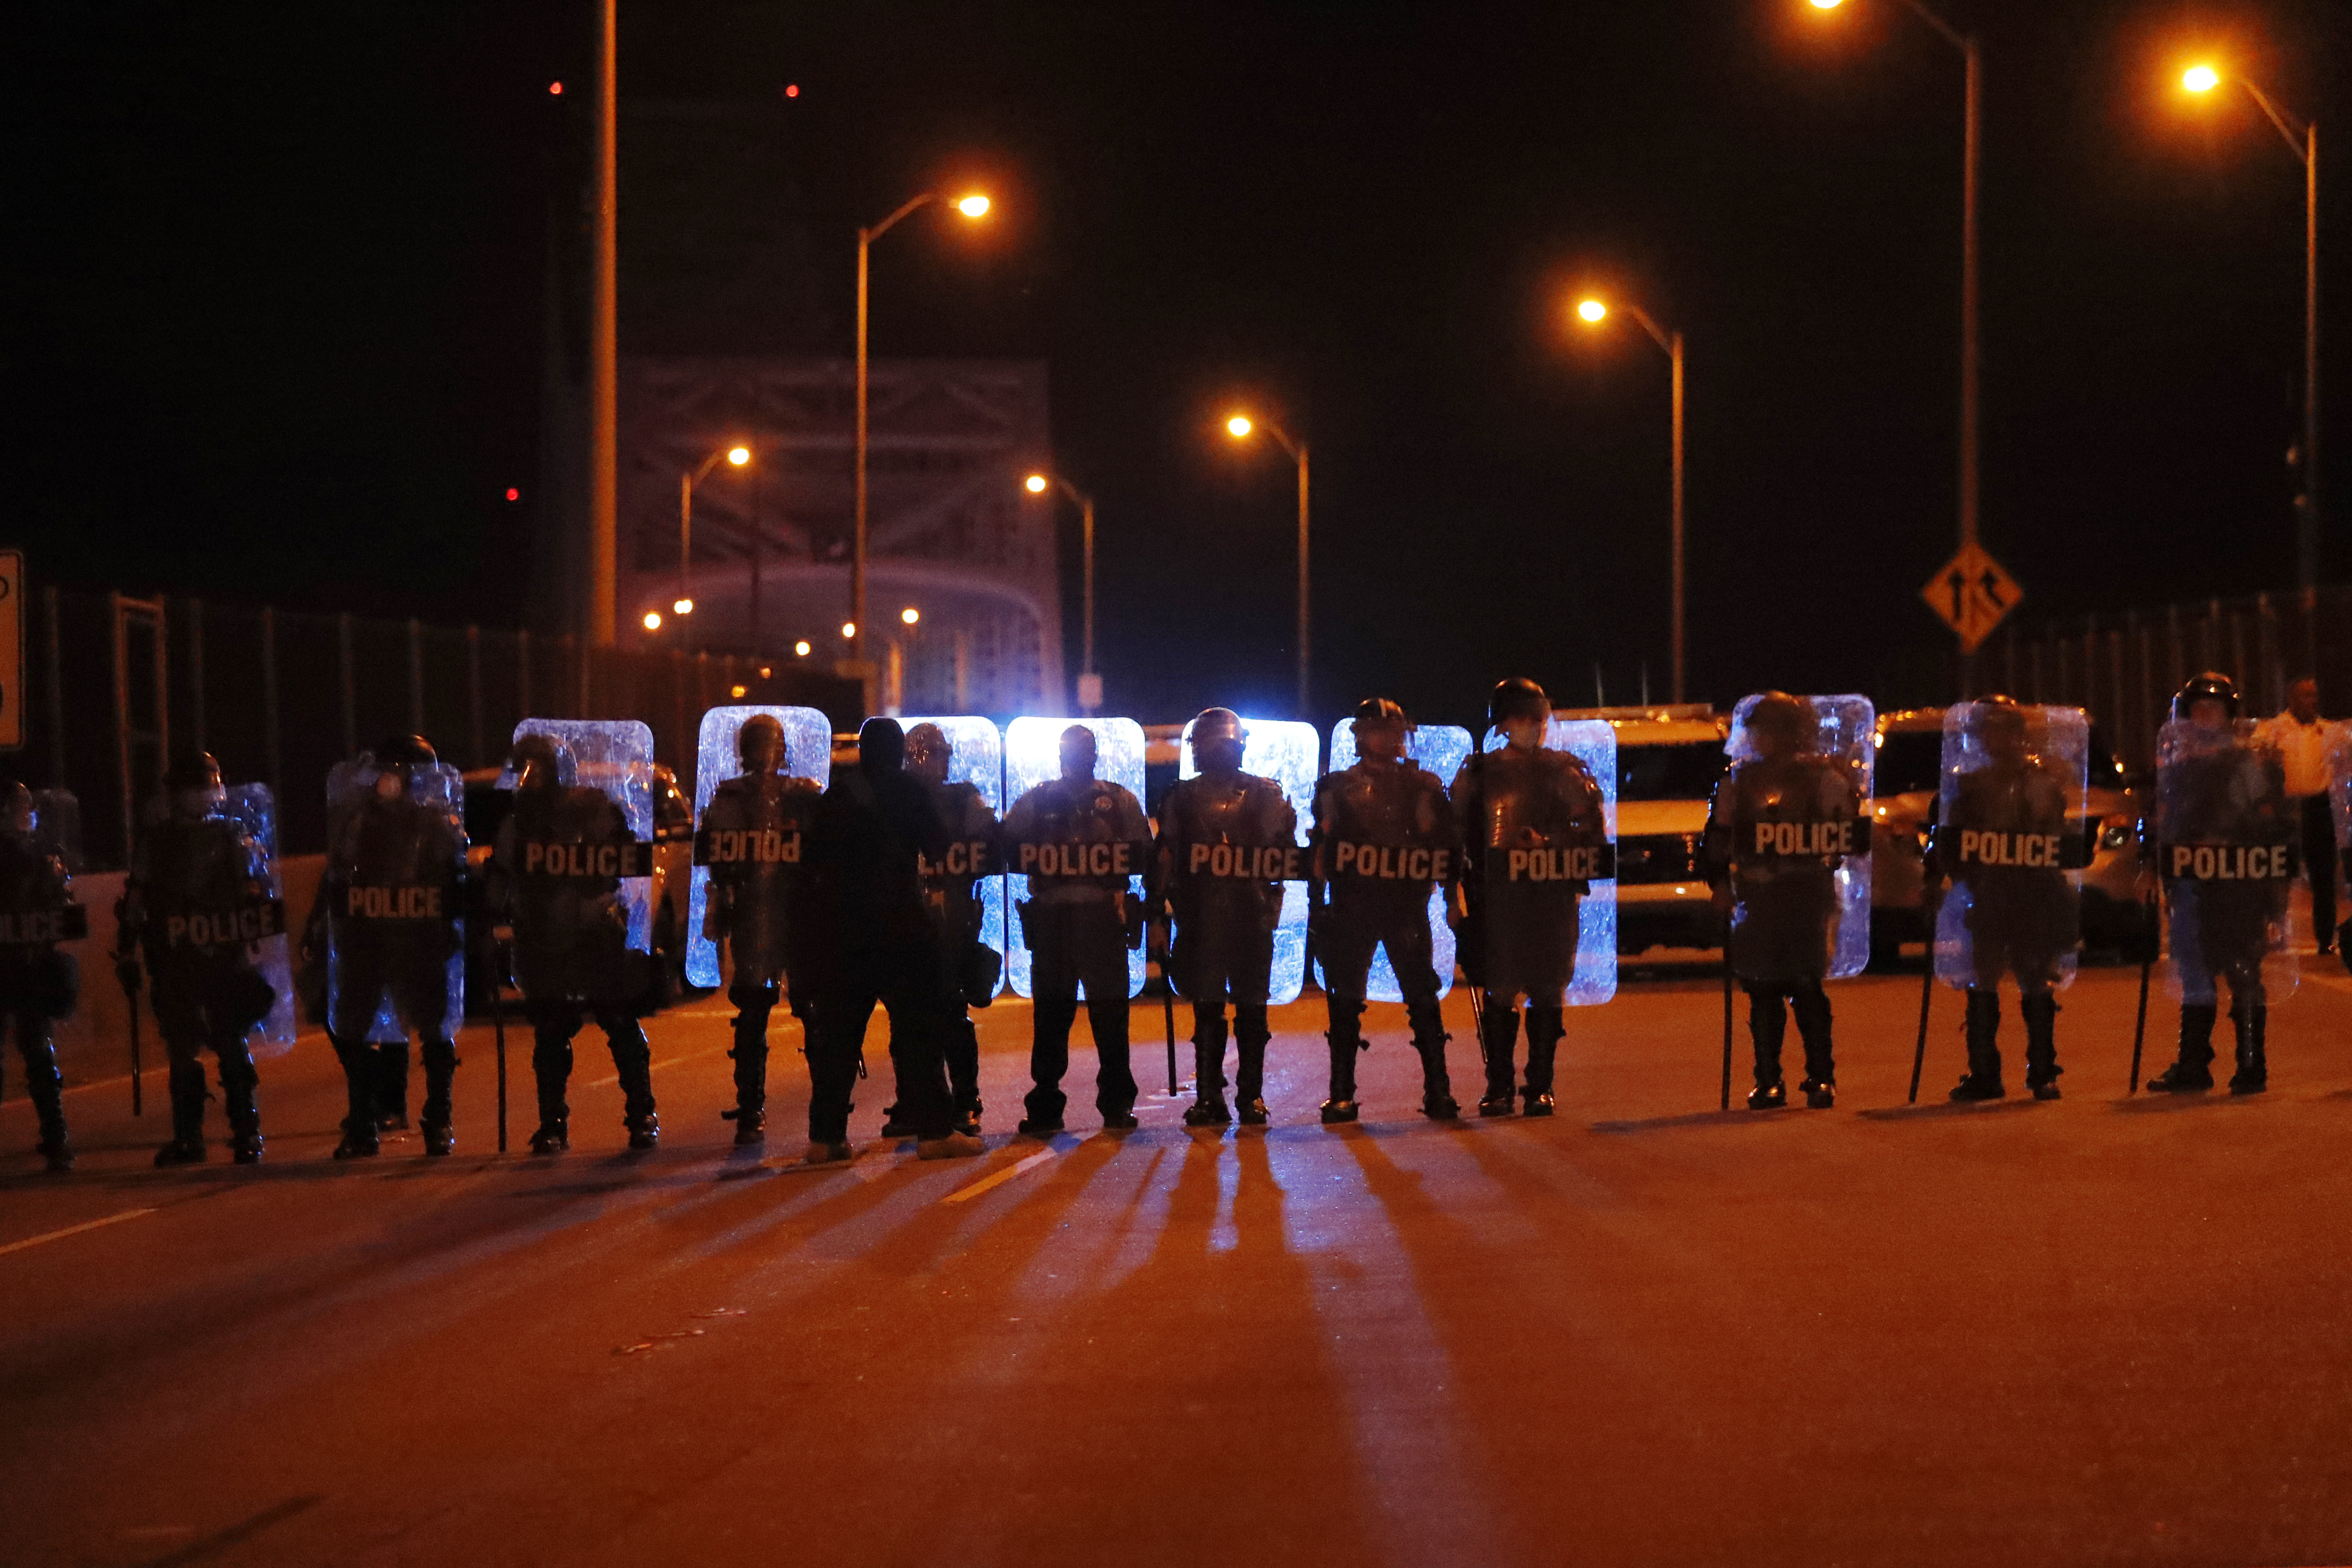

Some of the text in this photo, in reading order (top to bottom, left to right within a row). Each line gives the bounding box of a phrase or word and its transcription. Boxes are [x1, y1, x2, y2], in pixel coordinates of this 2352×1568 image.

[710, 830, 801, 863] POLICE
[1756, 820, 1853, 855] POLICE
[1961, 830, 2060, 867] POLICE
[527, 842, 638, 876] POLICE
[1020, 843, 1130, 876] POLICE
[1190, 843, 1299, 878] POLICE
[1336, 841, 1450, 880] POLICE
[1509, 847, 1599, 881] POLICE
[2173, 845, 2287, 879] POLICE
[348, 886, 442, 917] POLICE
[0, 912, 64, 943] LICE
[168, 903, 275, 947] POLICE
